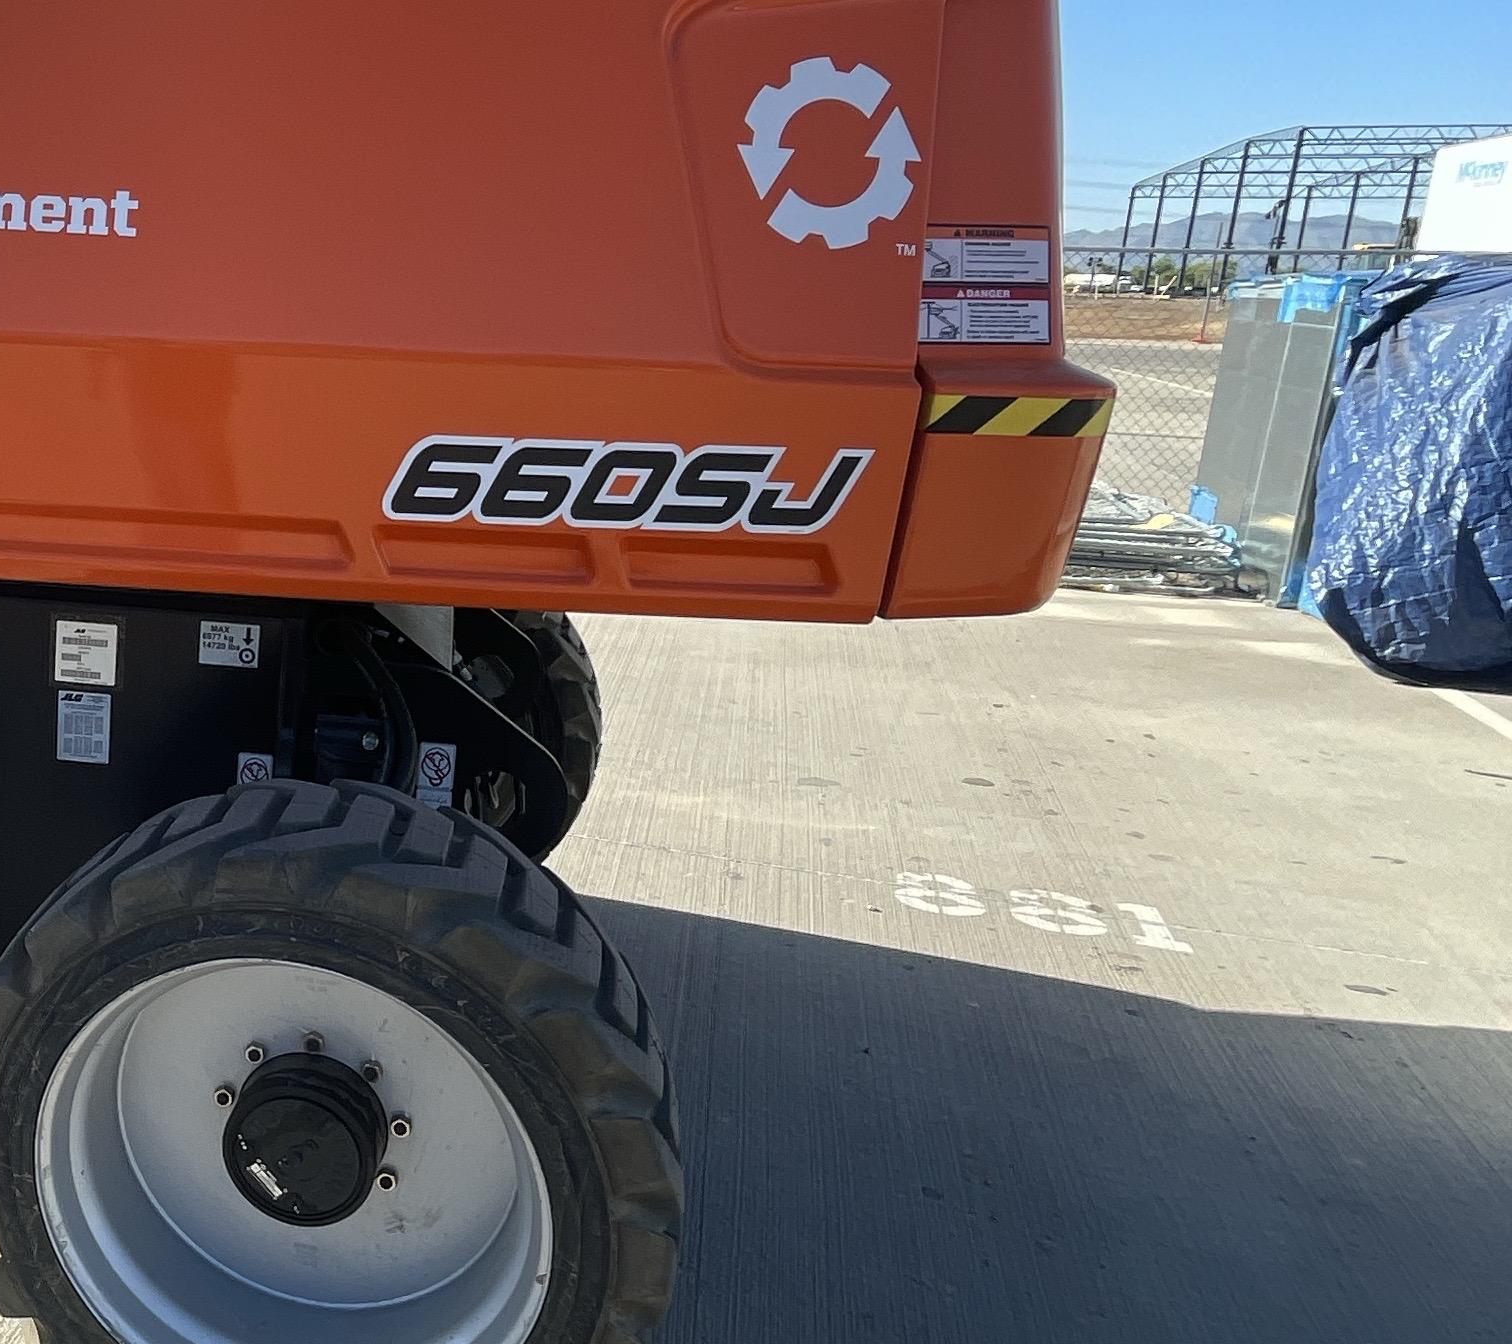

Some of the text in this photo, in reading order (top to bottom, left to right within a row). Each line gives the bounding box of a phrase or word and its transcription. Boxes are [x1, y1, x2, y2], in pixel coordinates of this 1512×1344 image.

[895, 243, 916, 257] TM
[966, 289, 1011, 298] DANGER
[382, 434, 876, 535] 660SJ
[60, 692, 84, 703] JLG
